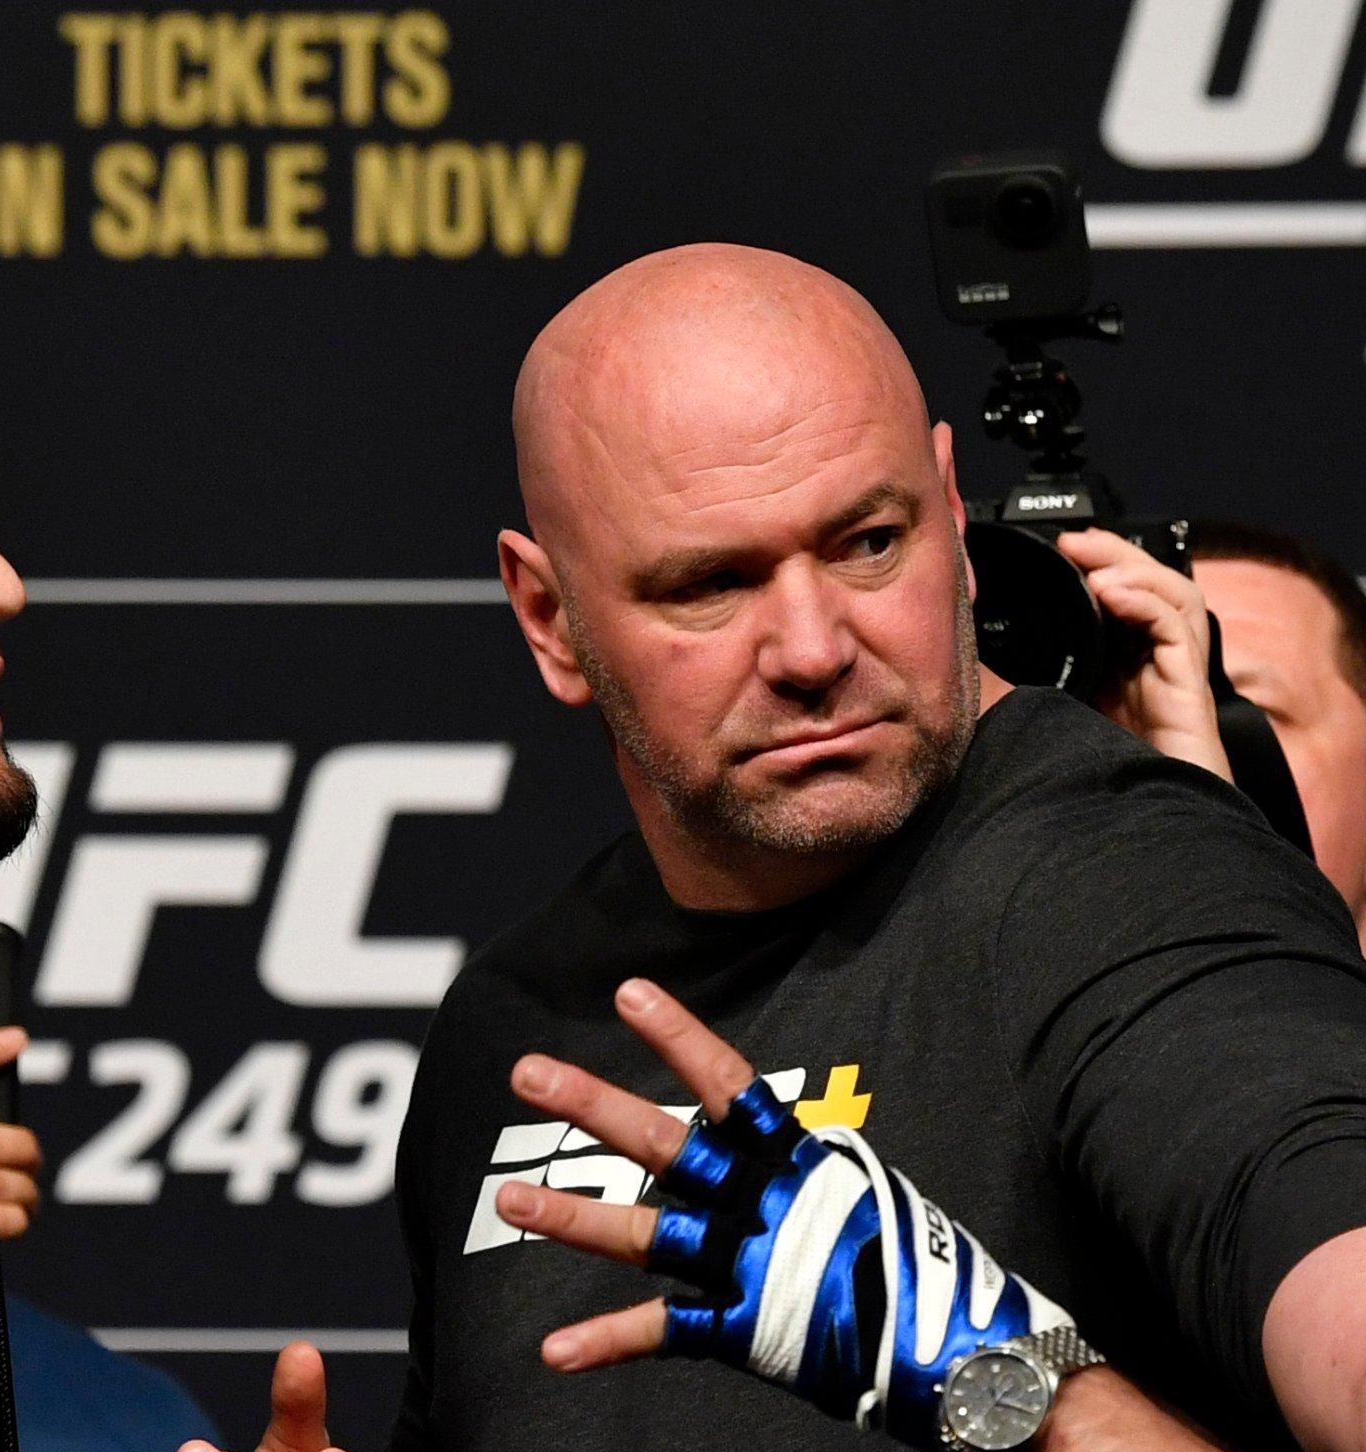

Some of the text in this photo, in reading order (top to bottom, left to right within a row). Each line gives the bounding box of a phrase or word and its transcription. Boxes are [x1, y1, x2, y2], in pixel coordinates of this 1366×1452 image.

[59, 10, 451, 128] TICKETS
[90, 141, 328, 260] SALE
[352, 141, 585, 260] NOW
[1018, 494, 1079, 511] SONY
[55, 1040, 422, 1206] 249
